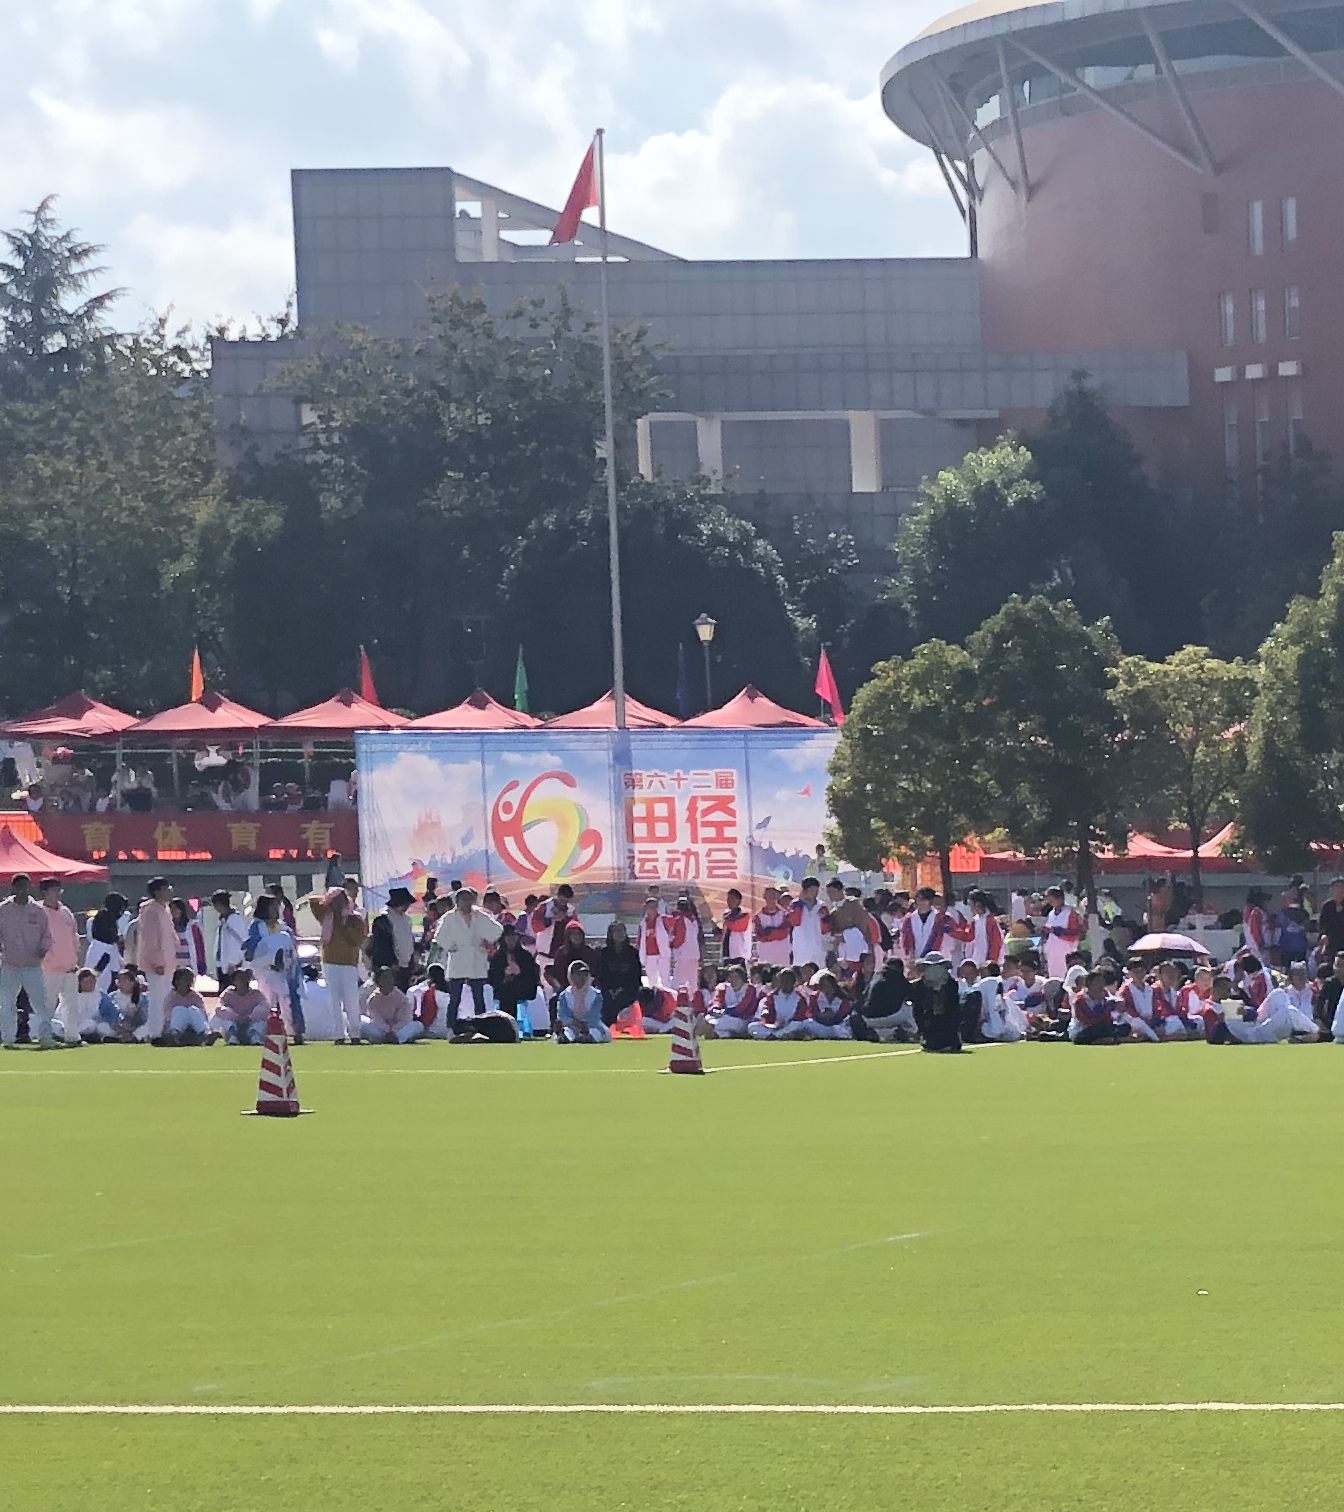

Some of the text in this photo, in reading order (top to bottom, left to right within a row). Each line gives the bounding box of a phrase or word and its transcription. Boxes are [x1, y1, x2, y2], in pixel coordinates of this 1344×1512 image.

[624, 771, 735, 790] 第六十二届
[625, 795, 738, 844] 田径
[628, 848, 738, 880] 运动会
